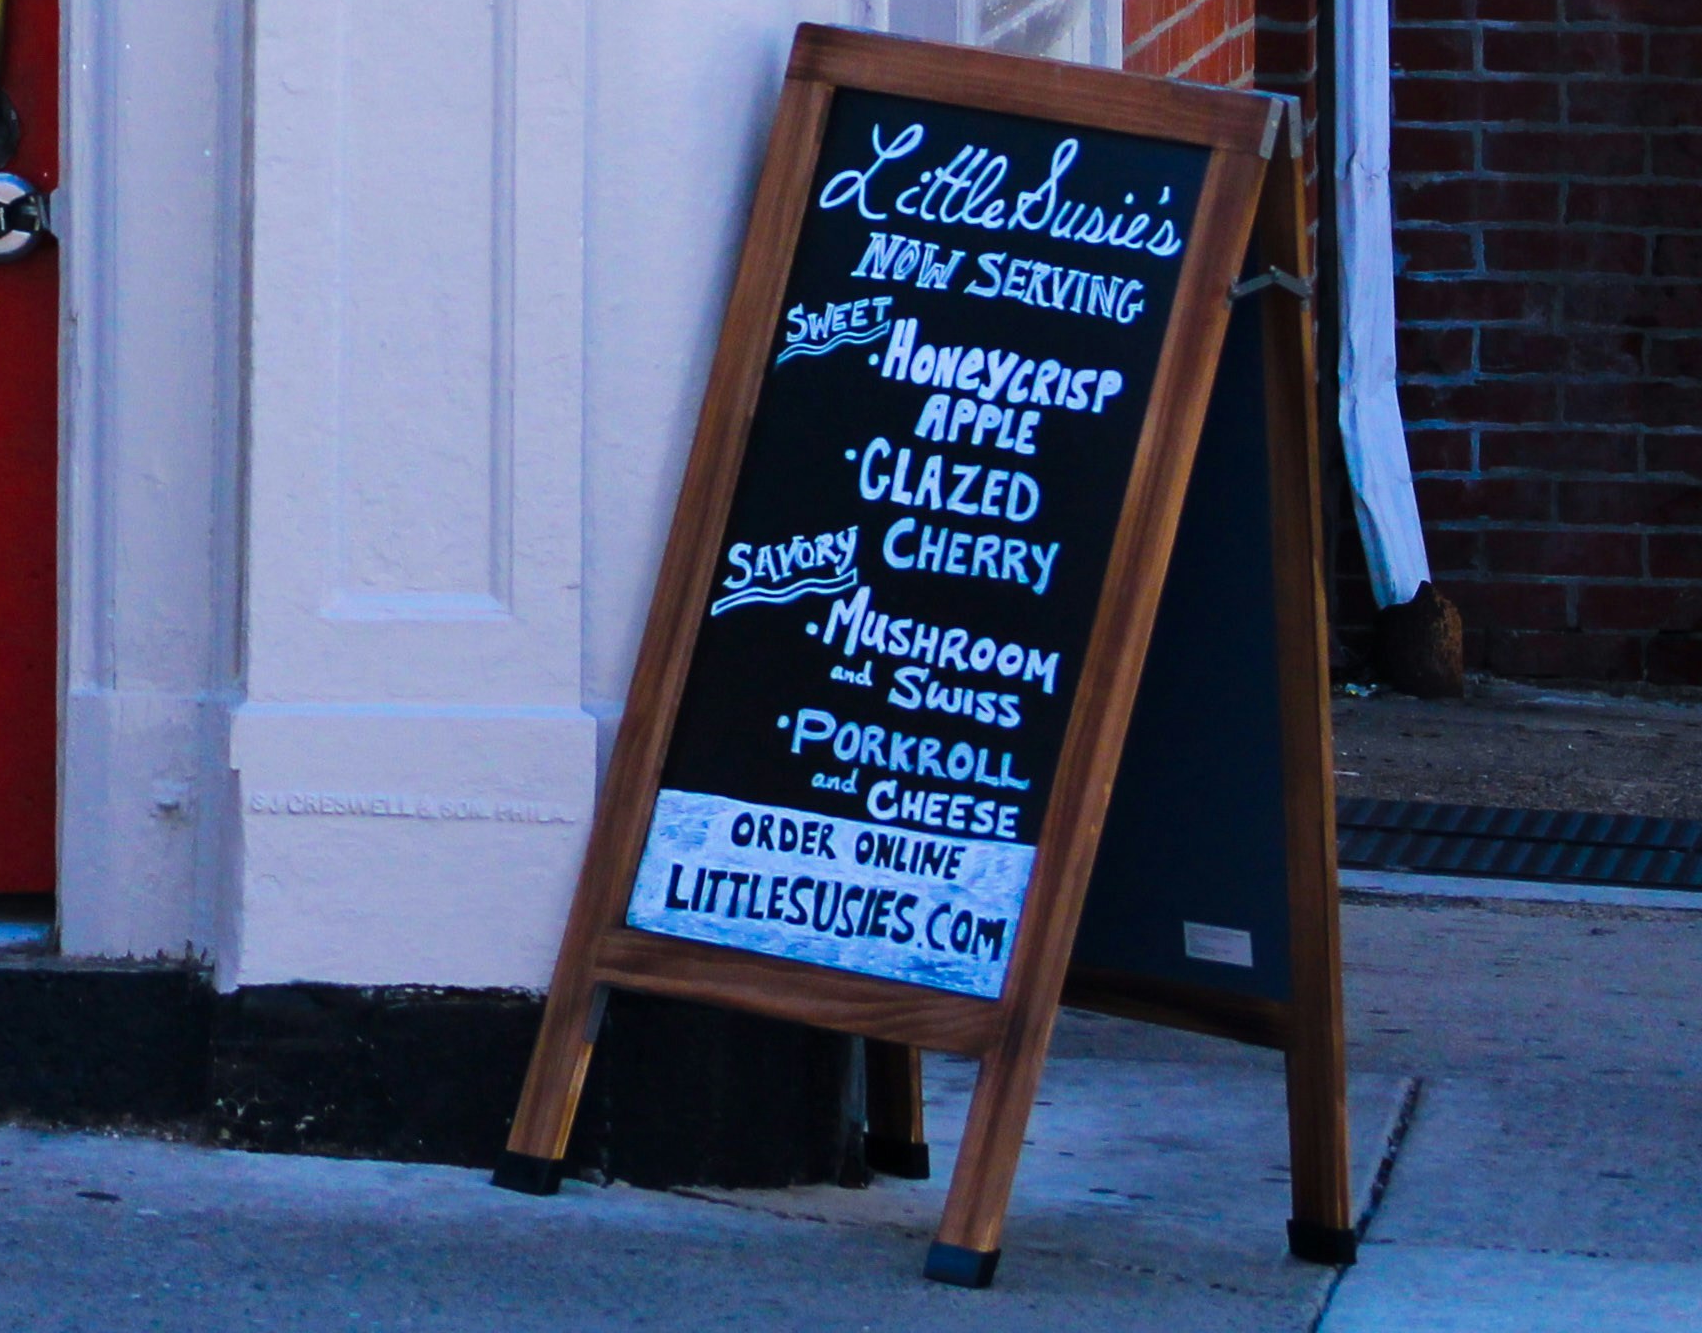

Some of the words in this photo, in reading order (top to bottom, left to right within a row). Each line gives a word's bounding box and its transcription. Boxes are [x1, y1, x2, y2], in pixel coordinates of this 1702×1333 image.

[851, 232, 966, 291] NOW
[965, 252, 1145, 324] SERVING
[785, 296, 893, 344] SWEET
[913, 393, 1040, 455] APPLE
[858, 437, 1040, 522] GLAZED
[722, 525, 859, 590] SAVORY
[881, 518, 1060, 596] CHERRY
[822, 586, 1060, 694] MUSHROOM
[830, 661, 873, 688] and
[887, 666, 1022, 729] SWISS
[790, 708, 1030, 791] PORKROLL
[811, 766, 858, 795] and
[866, 779, 1020, 839] CHEESE
[730, 811, 837, 861] ORDER
[854, 831, 966, 881] ONLINE
[663, 863, 1008, 962] LITTLESUSIES.COM
